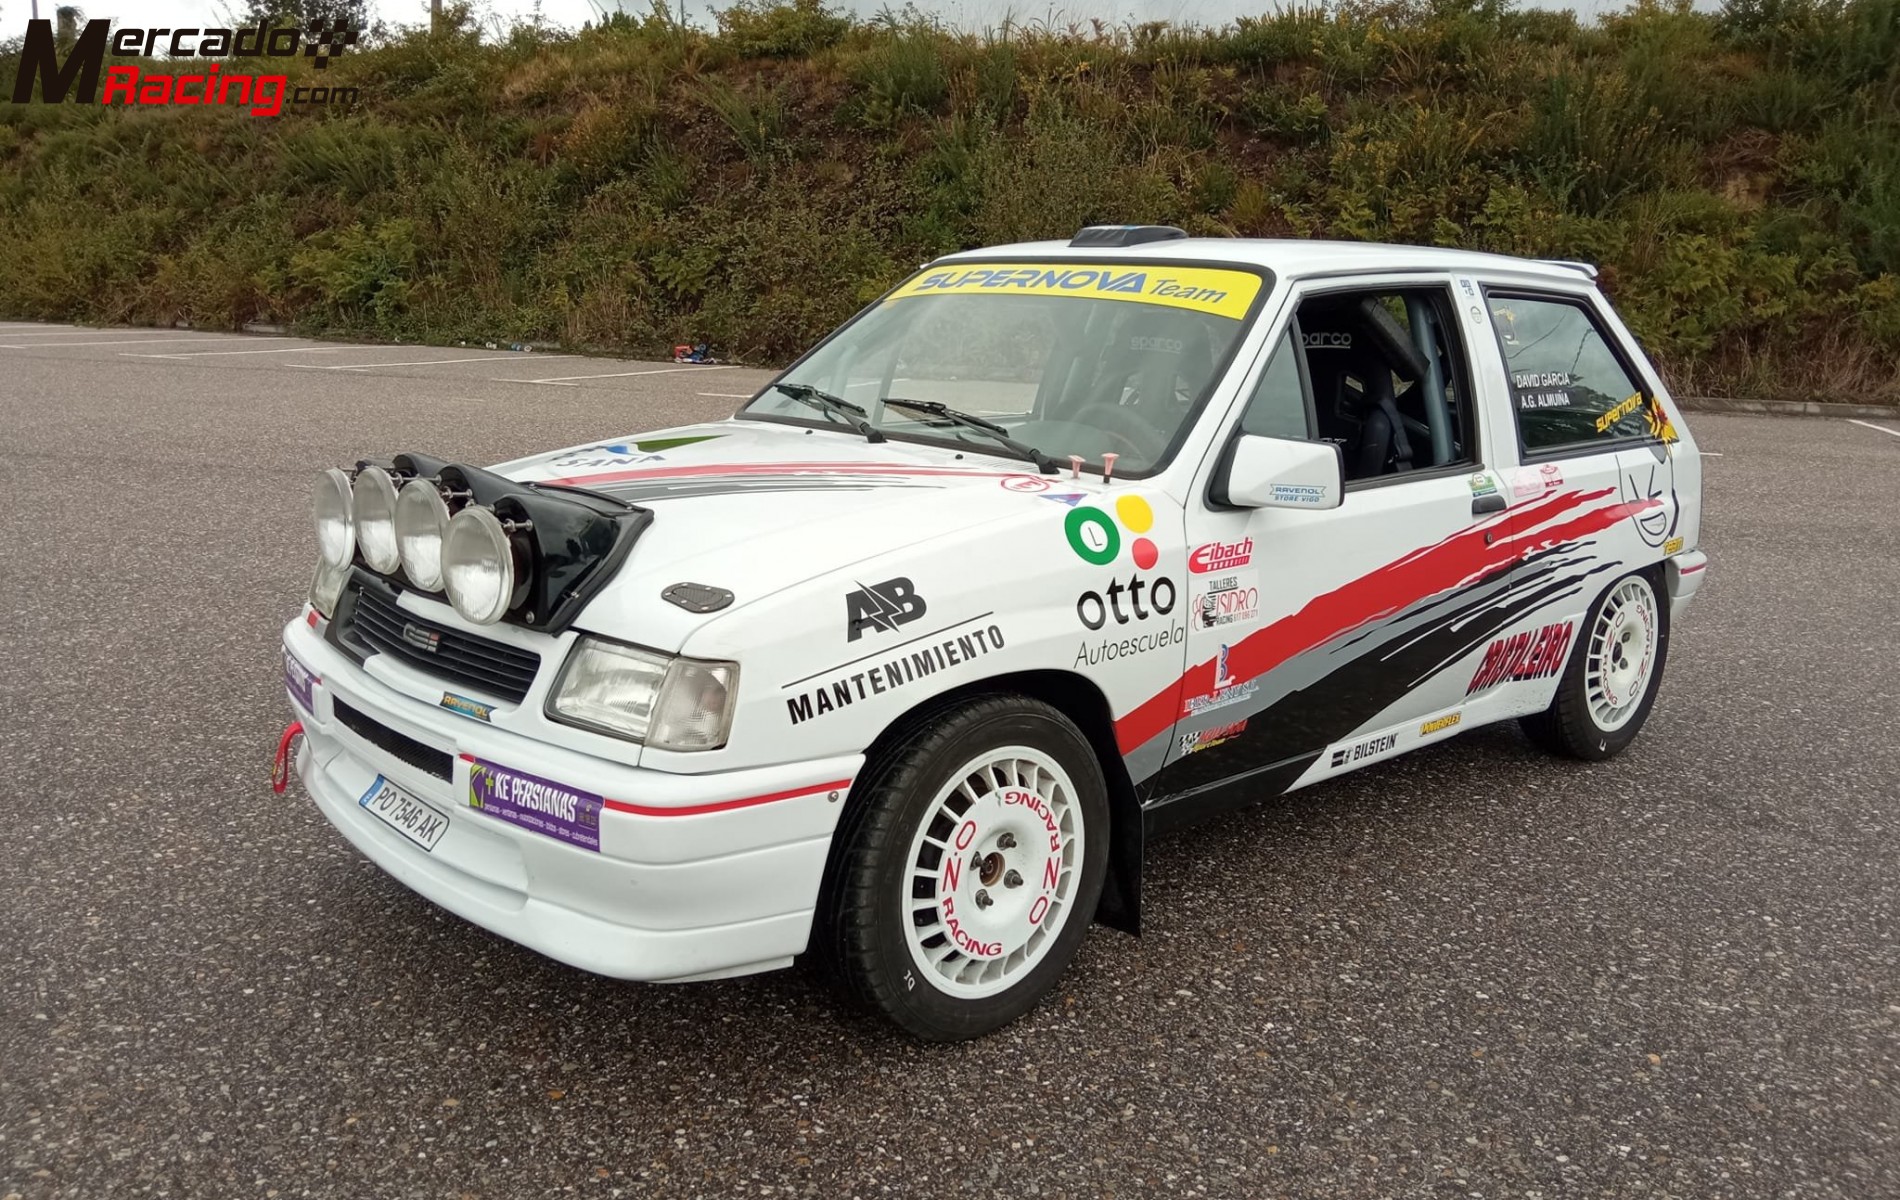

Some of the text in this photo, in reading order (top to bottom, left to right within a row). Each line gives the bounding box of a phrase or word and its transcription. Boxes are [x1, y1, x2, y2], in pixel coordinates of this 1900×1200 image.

[915, 269, 1228, 304] SUPERNOVA Team
[1130, 336, 1183, 353] sparco
[1516, 373, 1541, 388] DAVID
[1521, 391, 1570, 408] A.G. ALMUIÑA
[1274, 494, 1298, 503] STORE
[1275, 486, 1320, 495] RAVENOL
[1189, 536, 1253, 574] Eibach
[1077, 573, 1176, 631] otto
[1209, 576, 1238, 590] TALLERES
[845, 576, 927, 643] AB
[1073, 619, 1184, 669] Autoescuela
[786, 624, 1005, 725] MANTENIMIENTO
[1353, 733, 1397, 760] BILSTEIN
[372, 786, 398, 811] PO
[388, 796, 424, 830] 7546
[413, 814, 443, 842] AK
[511, 777, 578, 823] PERSIANAS
[1004, 790, 1060, 852] RACING
[942, 896, 1003, 957] RACING
